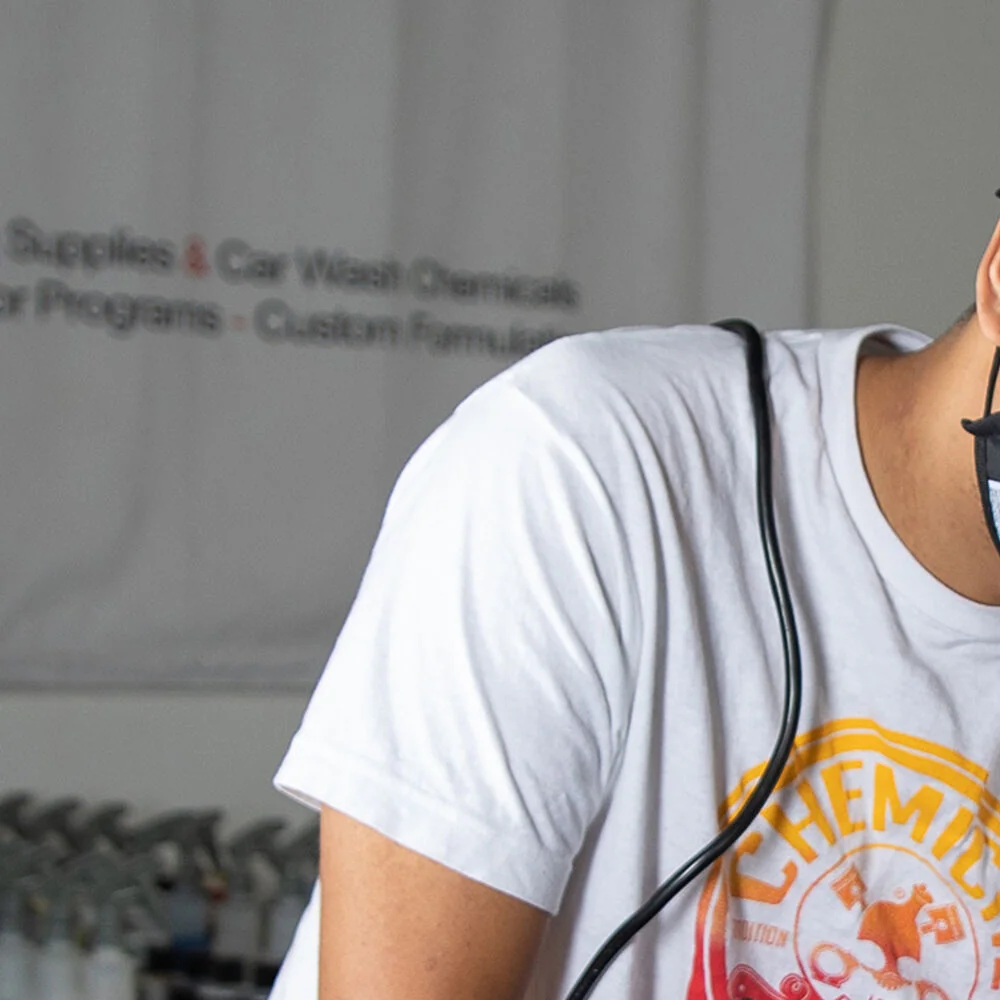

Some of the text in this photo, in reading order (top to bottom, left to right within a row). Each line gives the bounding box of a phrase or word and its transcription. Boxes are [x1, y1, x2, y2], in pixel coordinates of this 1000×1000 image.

[5, 217, 175, 273] Supplies
[217, 238, 288, 285] Car
[298, 247, 401, 294] Wash
[408, 257, 580, 311] Chemicals
[35, 279, 223, 339] Programs
[254, 298, 401, 347] Custom
